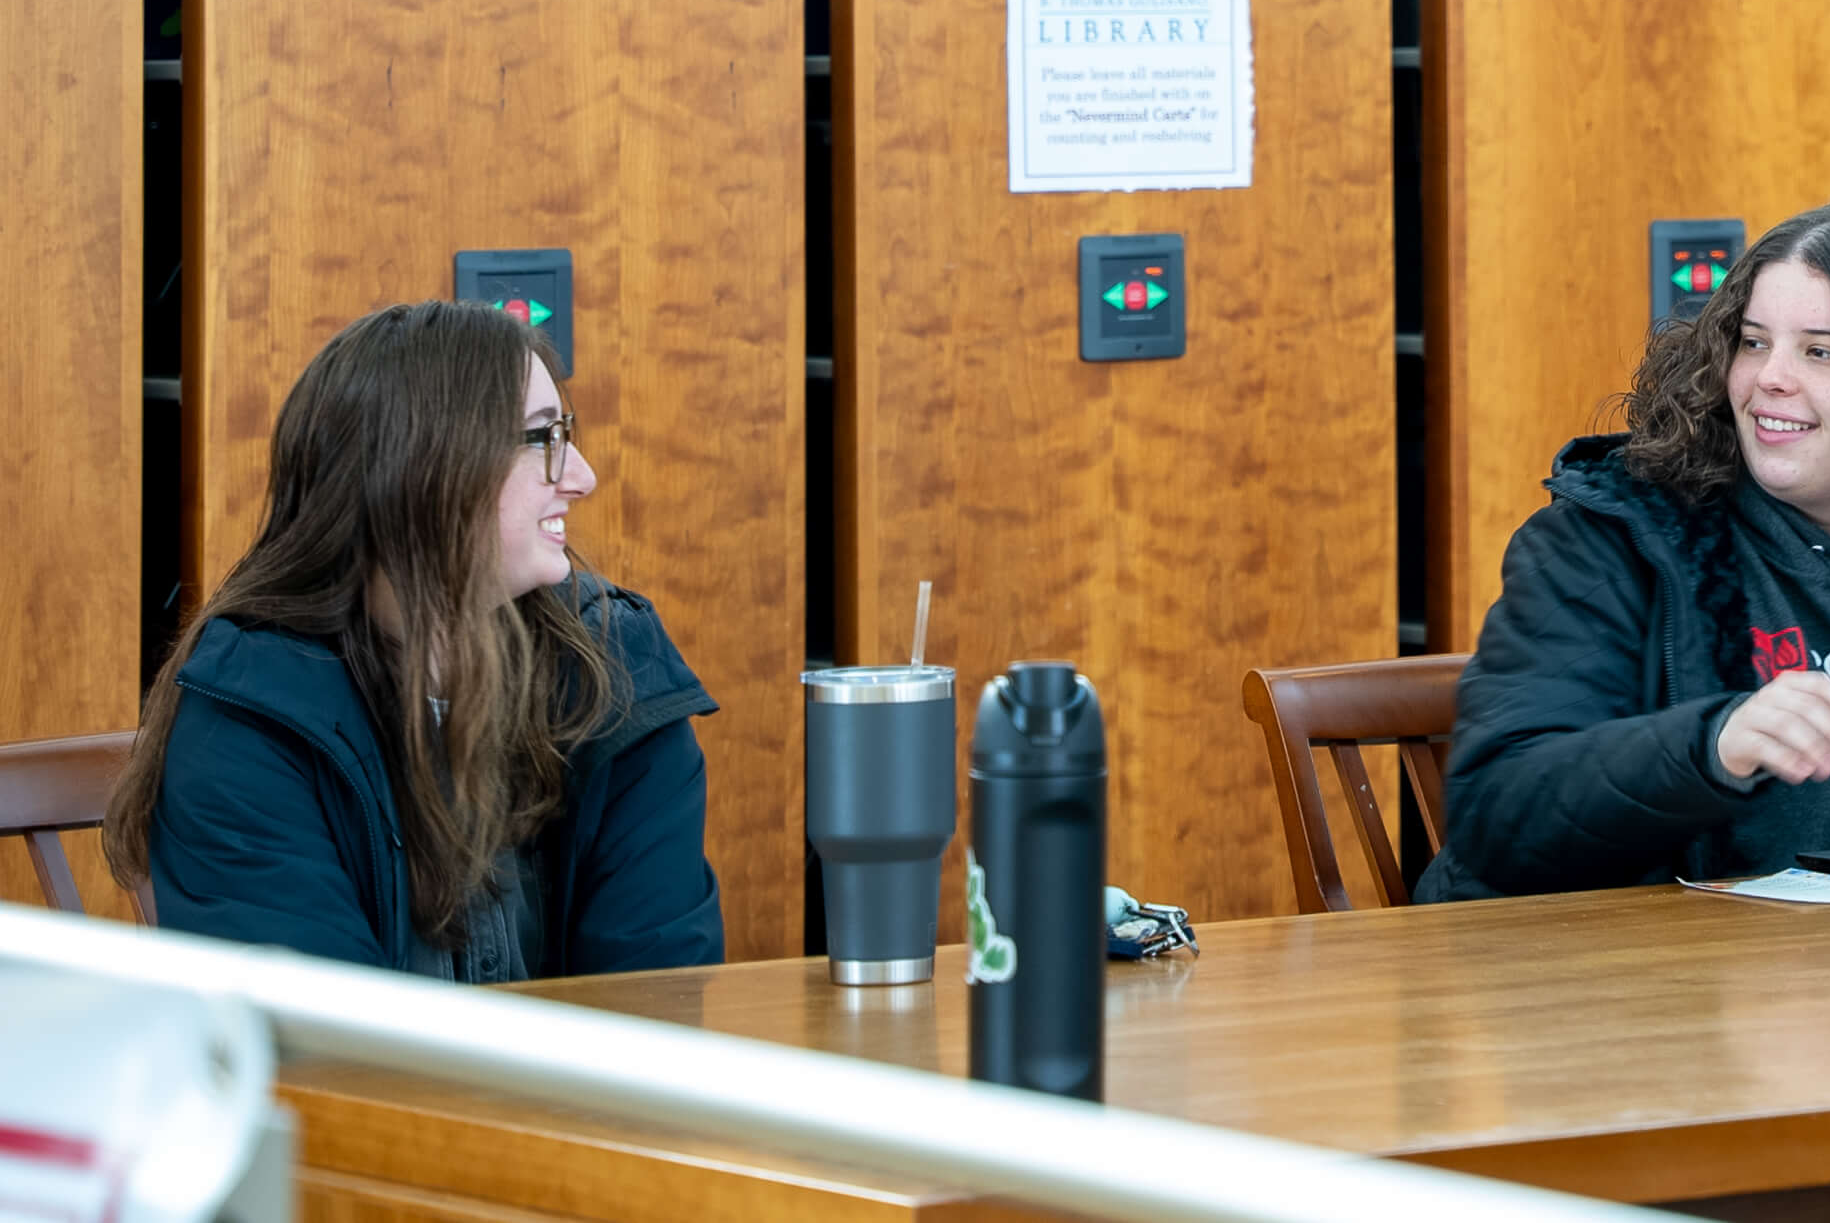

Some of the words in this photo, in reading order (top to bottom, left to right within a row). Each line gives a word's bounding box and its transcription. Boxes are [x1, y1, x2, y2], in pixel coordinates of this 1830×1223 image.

[1038, 19, 1210, 43] LIBRARY
[1041, 67, 1085, 82] Please
[1090, 68, 1125, 81] leave
[1129, 67, 1146, 80] all
[1152, 66, 1216, 80] materials
[1047, 93, 1070, 104] you
[1075, 92, 1097, 102] are
[1102, 89, 1155, 103] finished
[1161, 88, 1190, 100] with
[1039, 112, 1061, 124] the
[1200, 108, 1218, 121] for
[1112, 131, 1136, 143] and
[1142, 129, 1213, 144] reshelving
